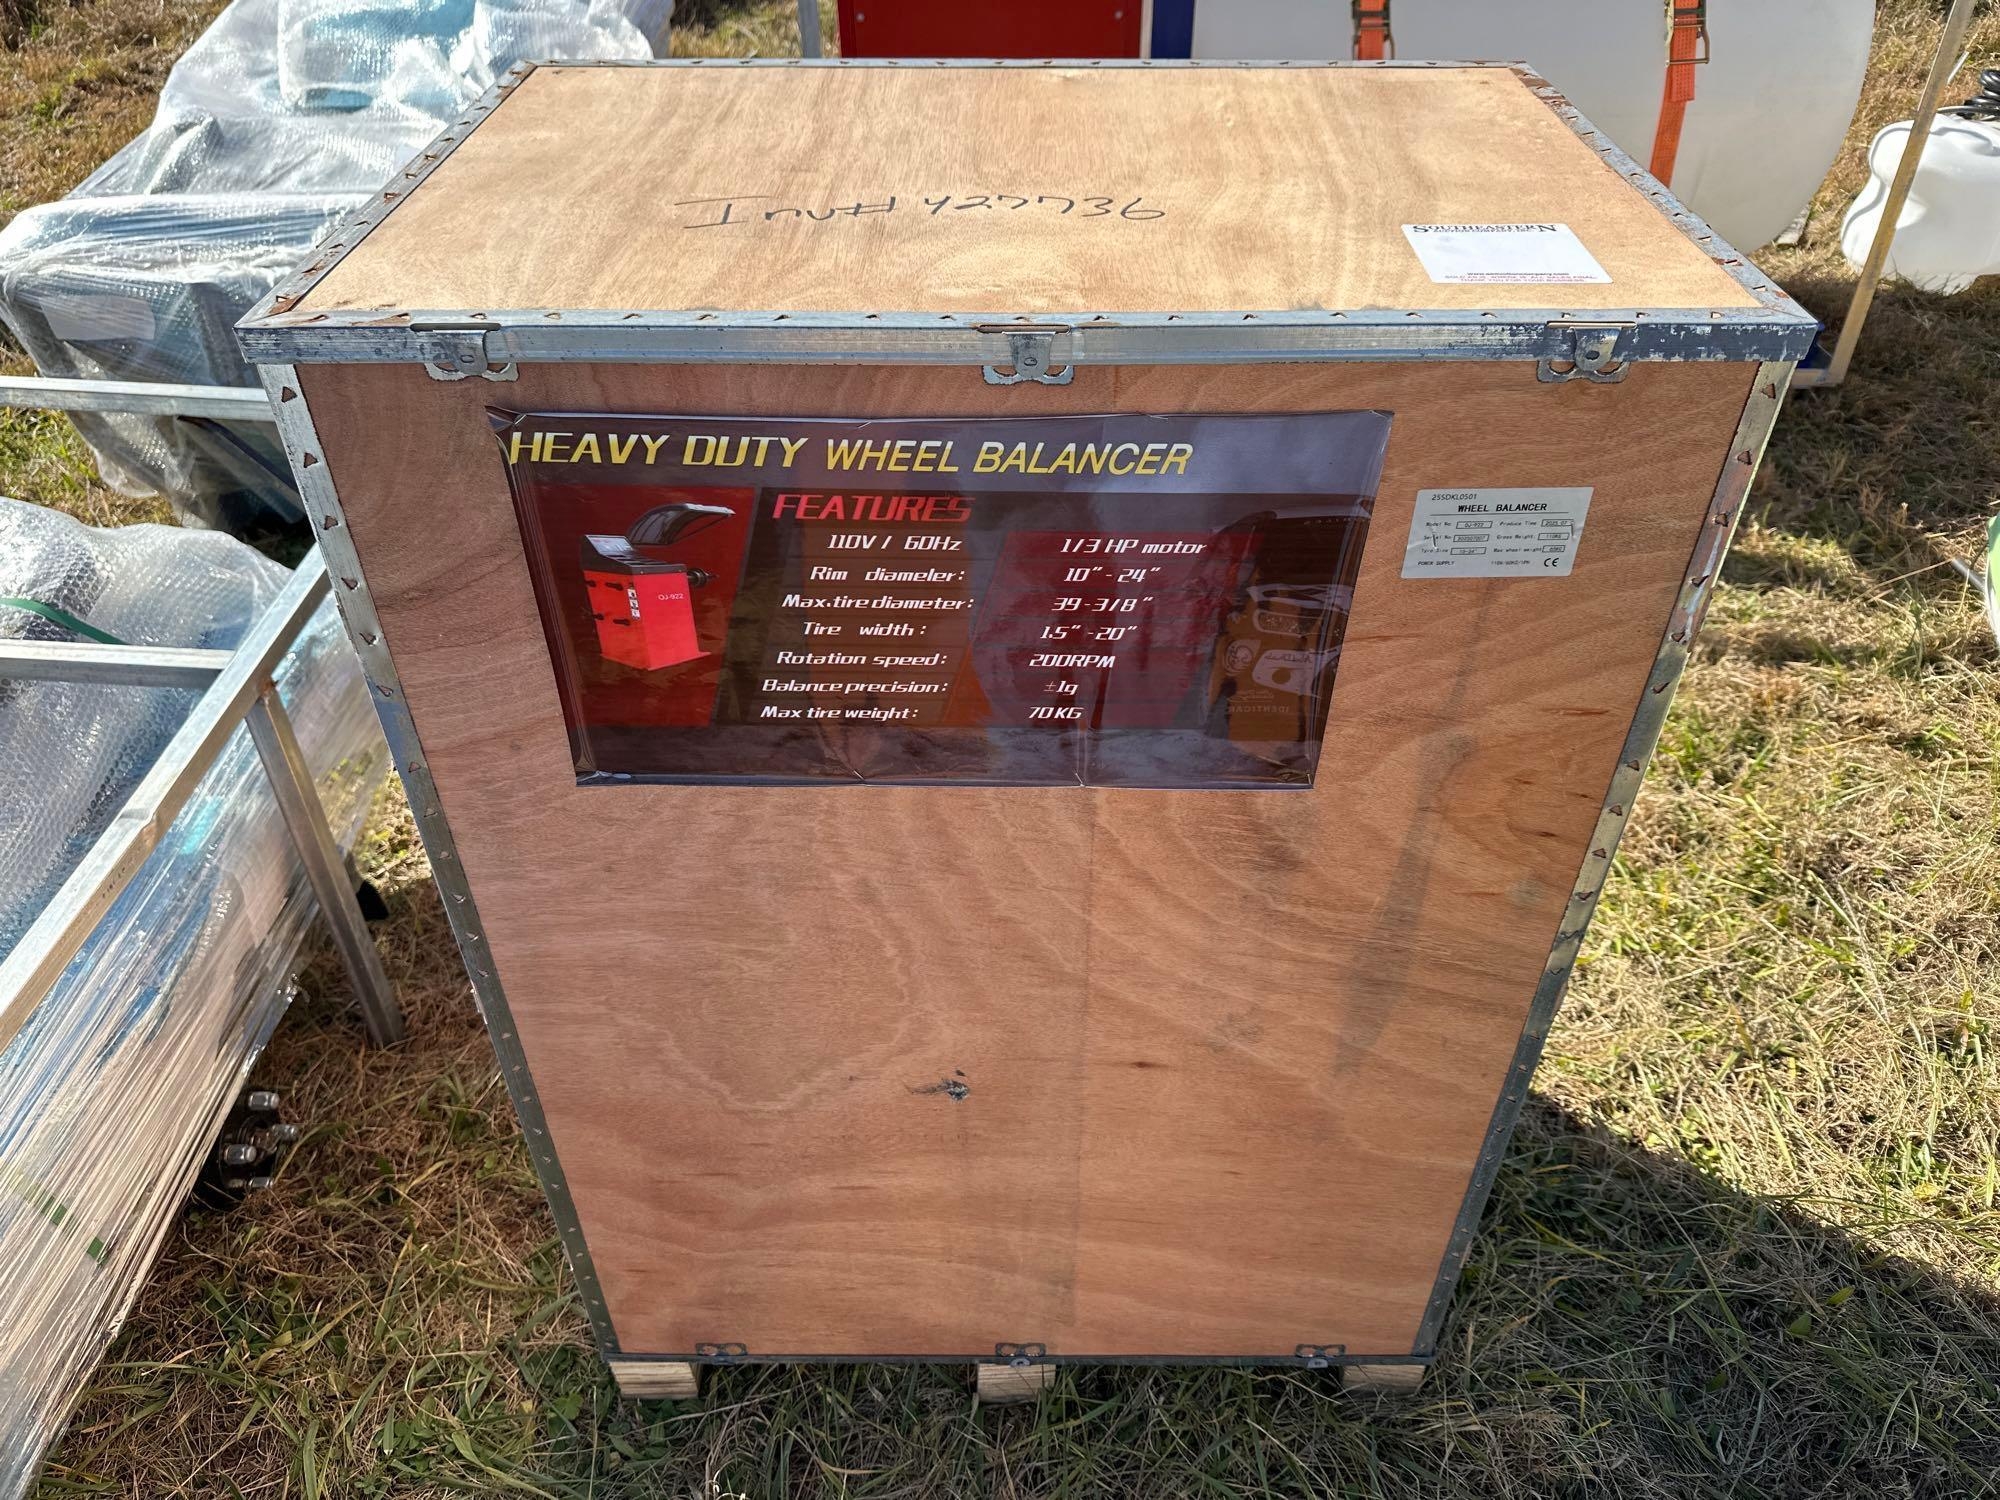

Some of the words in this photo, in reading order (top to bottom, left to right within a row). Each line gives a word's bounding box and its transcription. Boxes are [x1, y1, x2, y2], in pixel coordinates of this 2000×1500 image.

[510, 431, 672, 466] HEAVY
[682, 435, 809, 468] DUTY
[826, 438, 959, 473] WHEEL
[973, 441, 1194, 475] BALANCER
[772, 494, 976, 522] FEATURES
[1458, 504, 1489, 512] WHEEL
[1495, 503, 1548, 512] BALANCER
[904, 535, 963, 551] 60Hz
[1060, 538, 1102, 553] 1/3
[1104, 539, 1139, 554] HP
[1141, 540, 1207, 554] motor
[810, 566, 848, 580] Rim
[803, 621, 842, 636] Tire
[776, 651, 866, 665] Rotation
[871, 653, 947, 668] speed:
[1029, 653, 1115, 668] 200RPM
[762, 679, 842, 692] Balance
[844, 680, 948, 694] precision:
[760, 705, 801, 718] Max
[807, 706, 841, 719] tire
[844, 707, 918, 722] weight:
